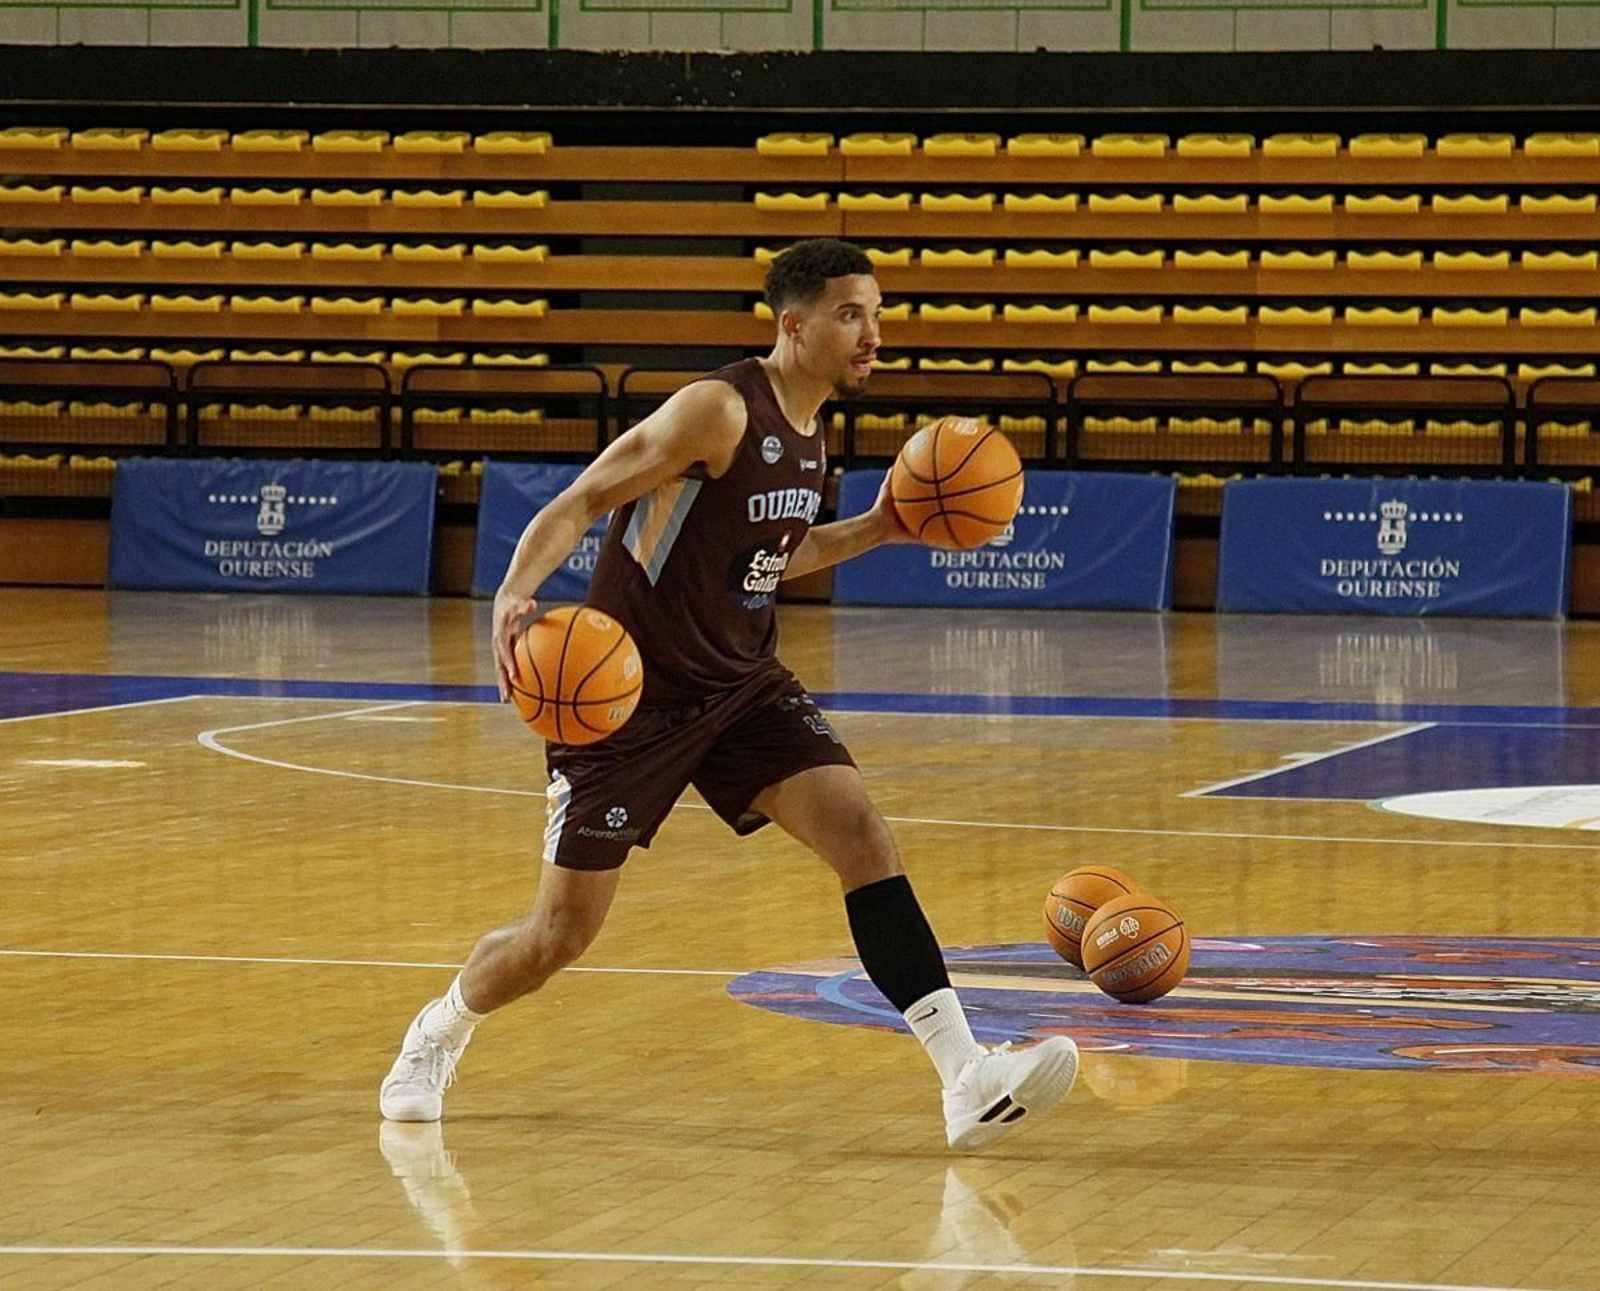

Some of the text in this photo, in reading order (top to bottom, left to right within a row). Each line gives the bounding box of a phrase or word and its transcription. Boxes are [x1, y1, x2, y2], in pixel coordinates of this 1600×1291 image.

[204, 538, 335, 558] DEPUTACIÓN
[219, 560, 315, 578] OURENSE
[930, 548, 1065, 570] DEPUTACIÓN
[1321, 555, 1460, 578] DEPUTACIÓN
[946, 570, 1046, 589] OURENSE
[1337, 578, 1440, 598] OURENSE
